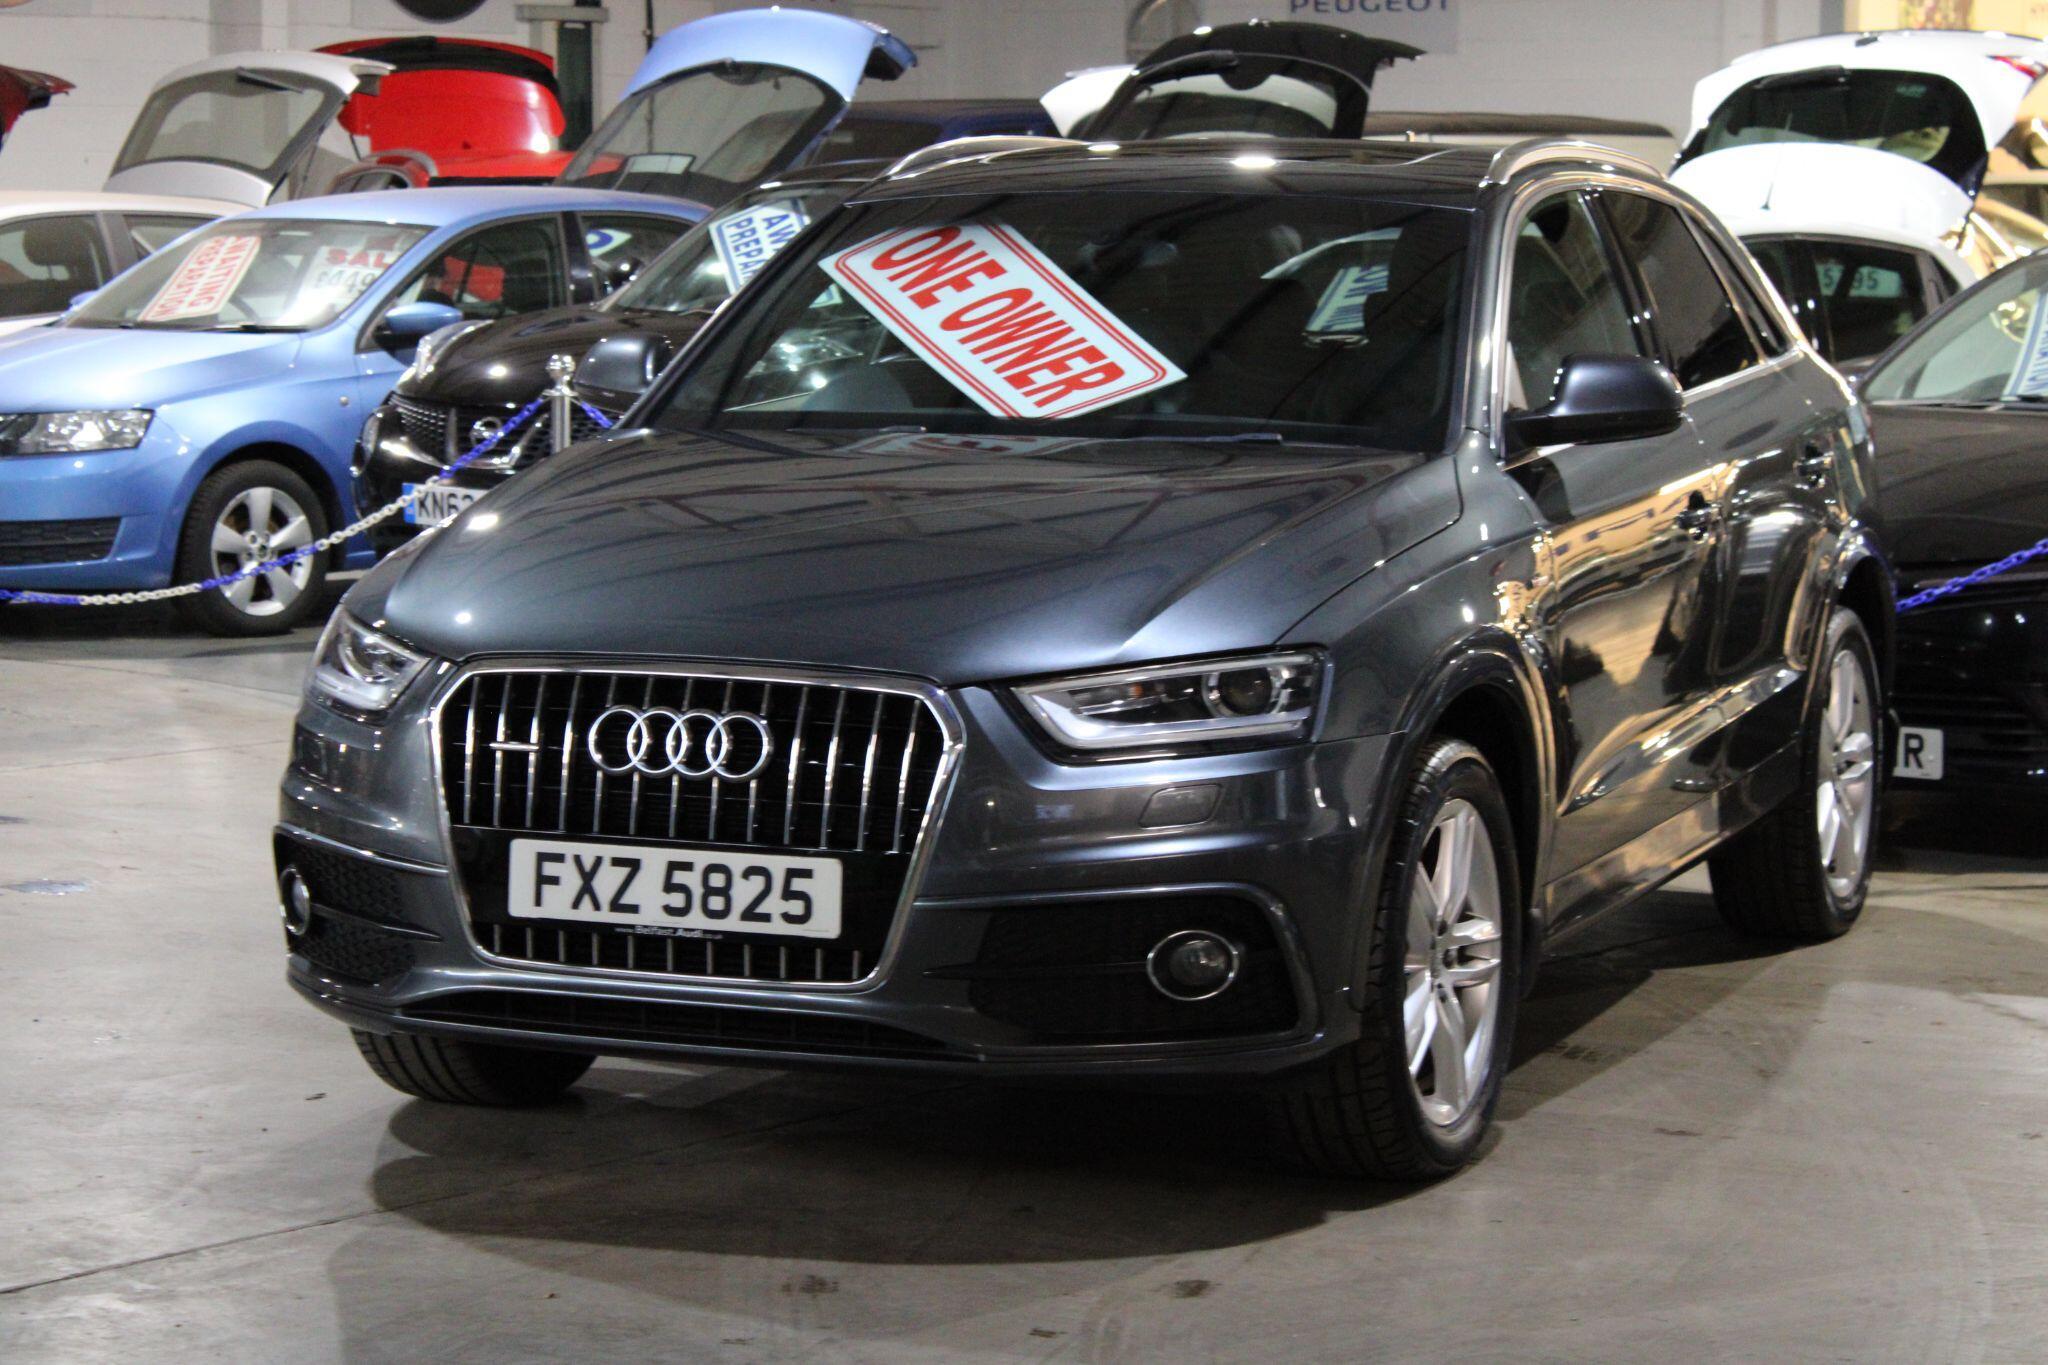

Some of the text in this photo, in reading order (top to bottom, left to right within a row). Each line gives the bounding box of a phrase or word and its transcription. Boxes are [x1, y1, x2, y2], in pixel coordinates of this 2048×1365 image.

[1290, 0, 1449, 13] PEUGEOT
[326, 248, 391, 268] SAL
[871, 227, 1125, 408] ONE OWNER
[1904, 733, 1924, 769] R
[534, 852, 813, 924] FXZ 5825
